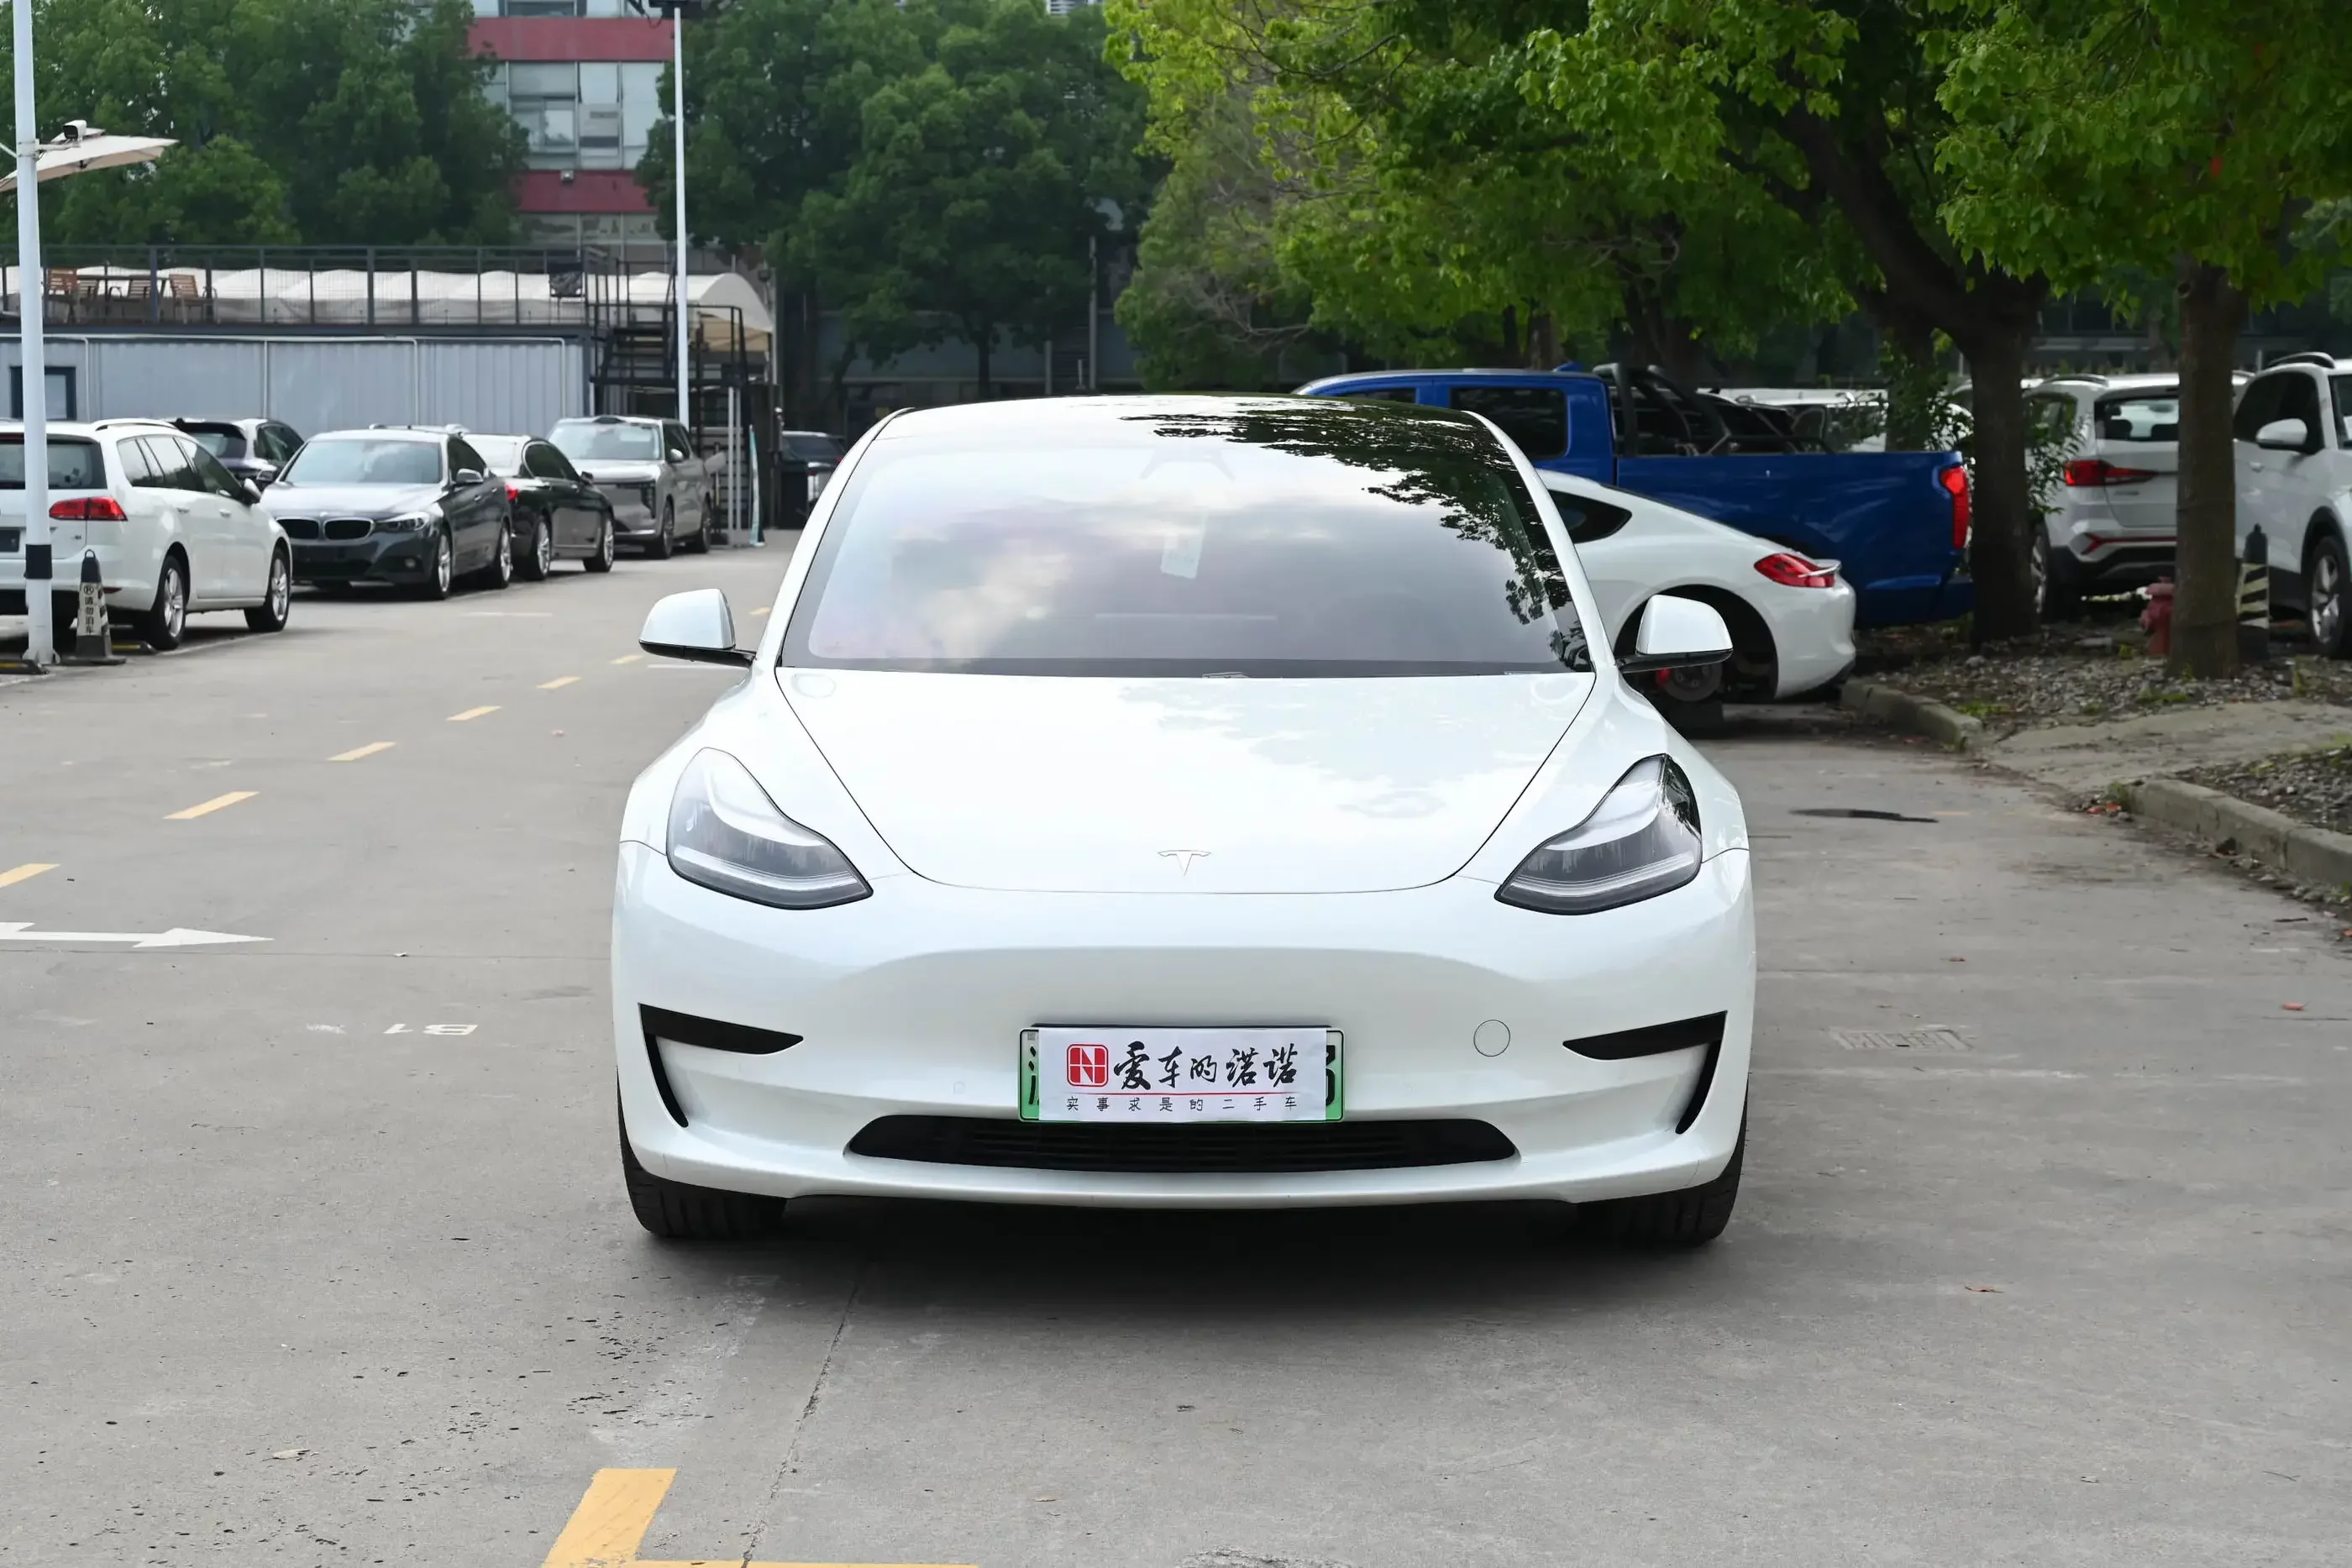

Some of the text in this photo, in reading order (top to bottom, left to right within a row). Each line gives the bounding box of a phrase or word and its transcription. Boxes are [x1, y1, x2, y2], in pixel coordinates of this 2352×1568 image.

[1066, 1096, 1298, 1112] 实事求是的二手车
